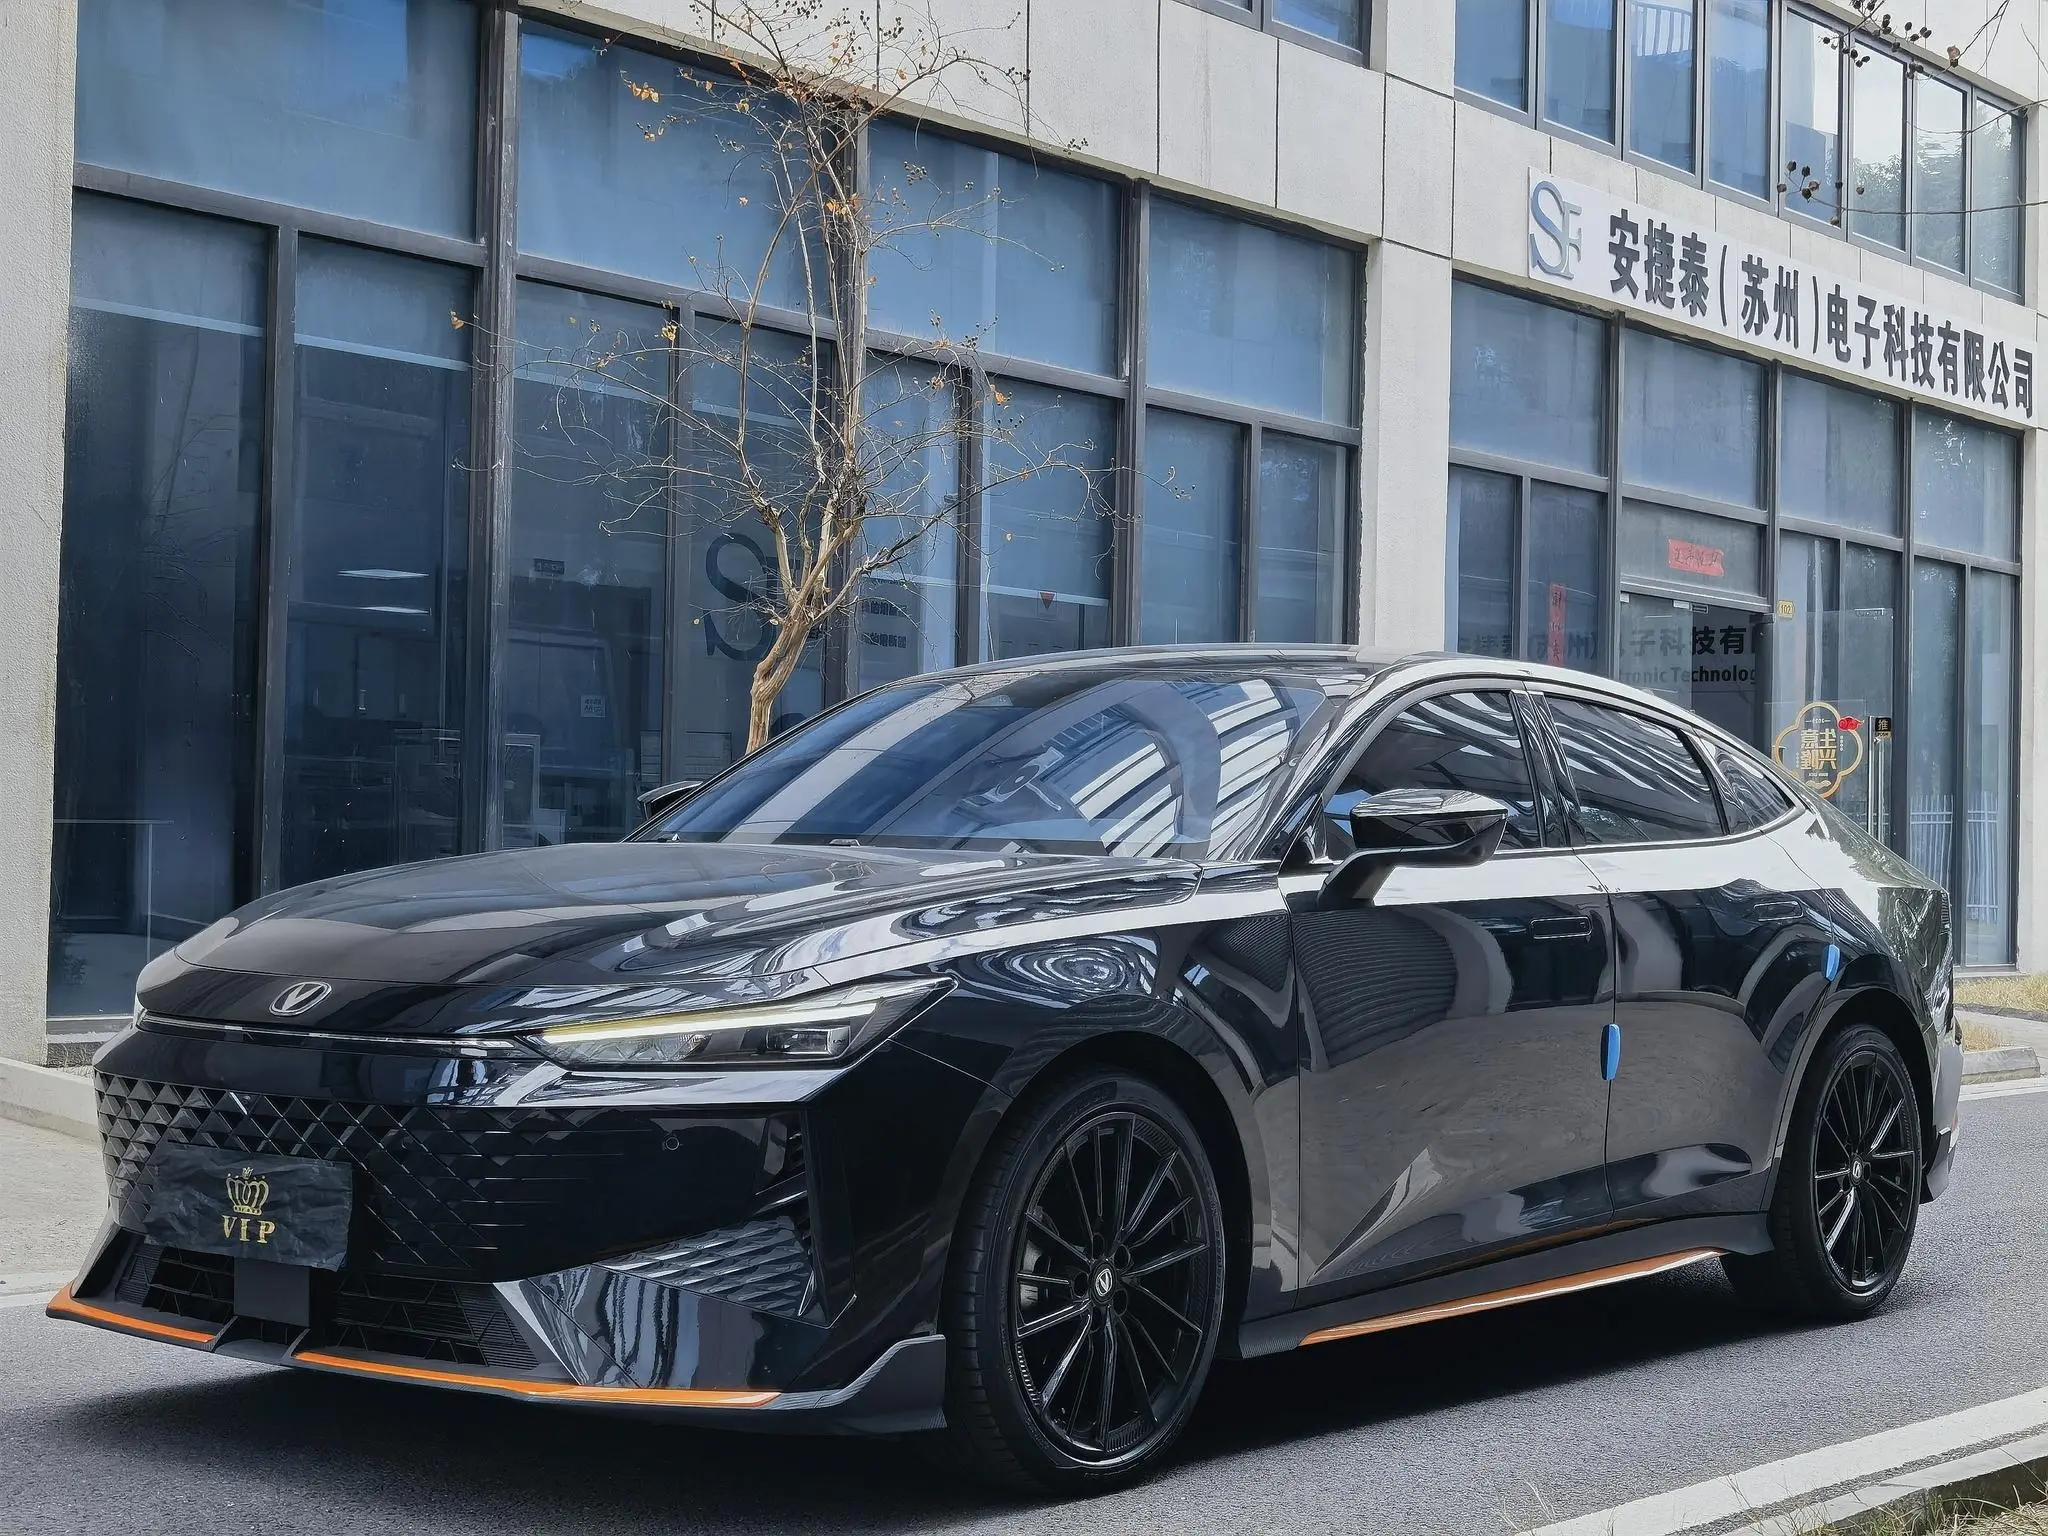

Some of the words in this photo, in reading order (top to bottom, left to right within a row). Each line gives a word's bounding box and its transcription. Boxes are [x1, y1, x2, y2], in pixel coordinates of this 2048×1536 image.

[1529, 180, 1582, 280] SF
[1608, 207, 2033, 419] 安捷泰（苏州）电子科技有限公司
[222, 1214, 276, 1244] VIP
